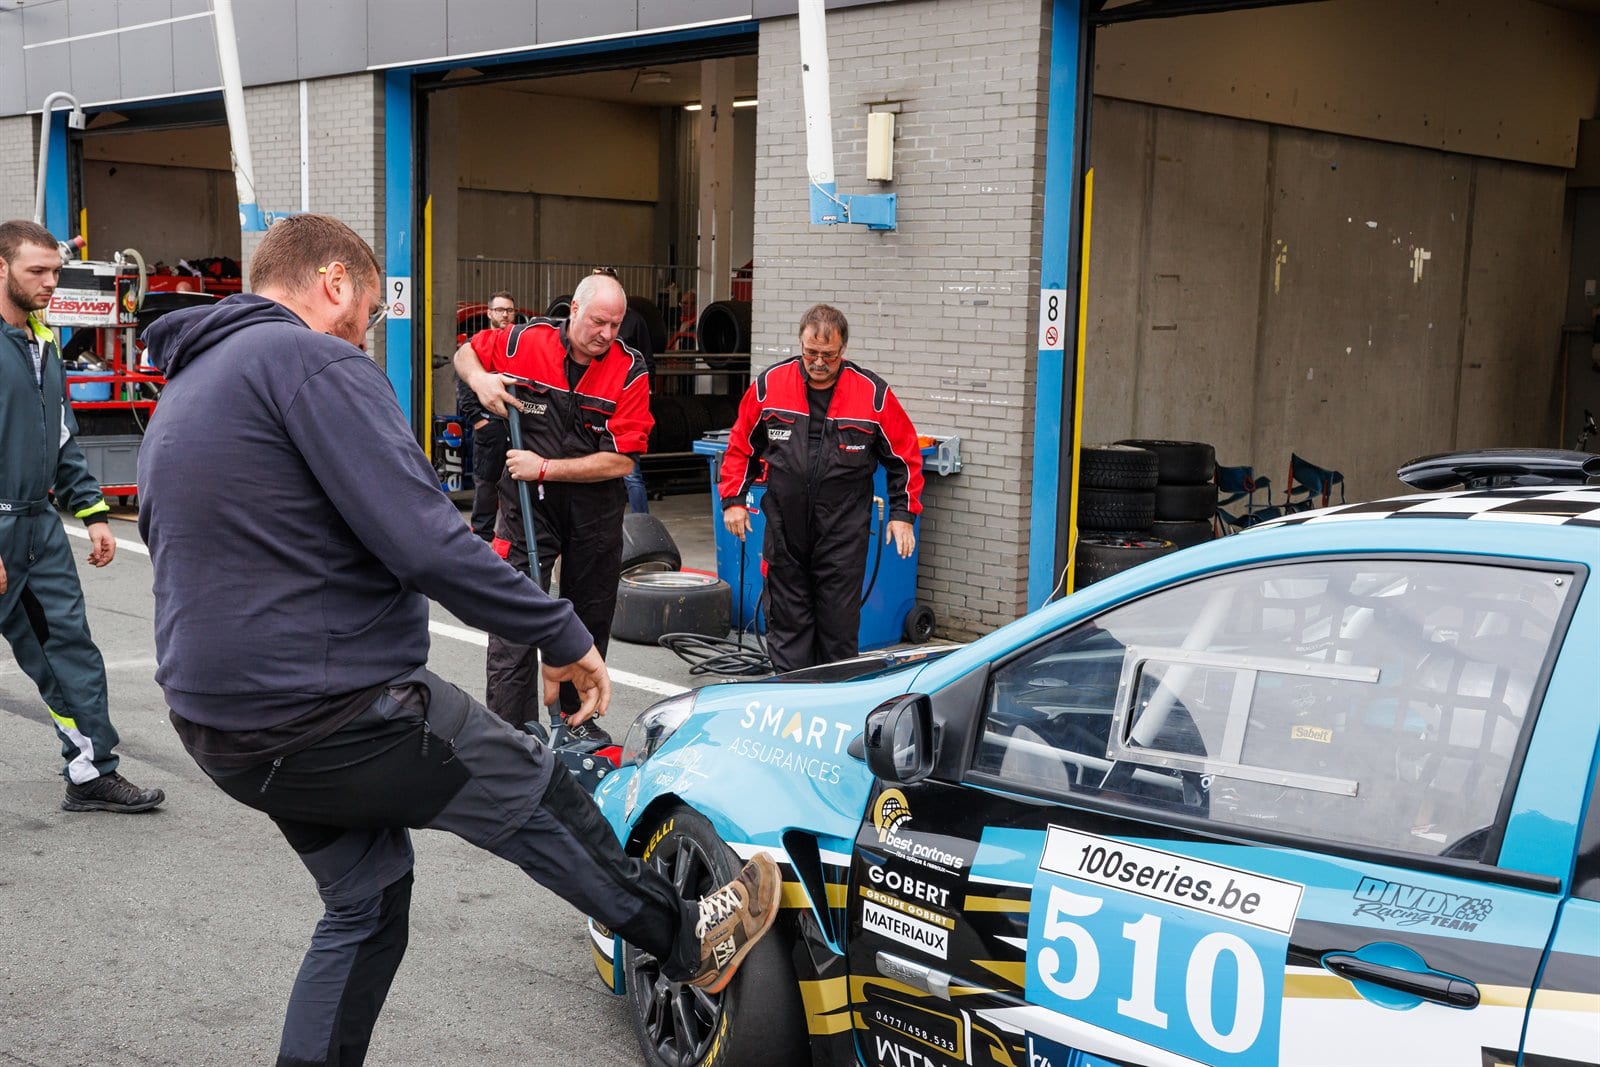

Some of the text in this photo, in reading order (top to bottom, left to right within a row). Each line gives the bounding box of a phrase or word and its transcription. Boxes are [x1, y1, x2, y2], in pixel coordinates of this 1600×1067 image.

[49, 296, 115, 314] Easyway
[394, 281, 404, 300] 9
[1048, 295, 1058, 321] 8
[60, 314, 76, 323] Stop
[78, 315, 109, 325] Smoking
[739, 700, 853, 755] SMART
[1295, 726, 1331, 744] Sabelt
[727, 736, 842, 786] ASSURANCES
[886, 832, 965, 870] best partners
[868, 865, 950, 908] GOBERT
[1078, 843, 1262, 915] 100series.be
[1352, 876, 1467, 920] DIVOY
[866, 889, 948, 926] GROUPE GOBERT
[1352, 902, 1478, 933] Racing TEAM
[864, 908, 945, 951] MATERIAUX
[1037, 885, 1266, 1055] 510
